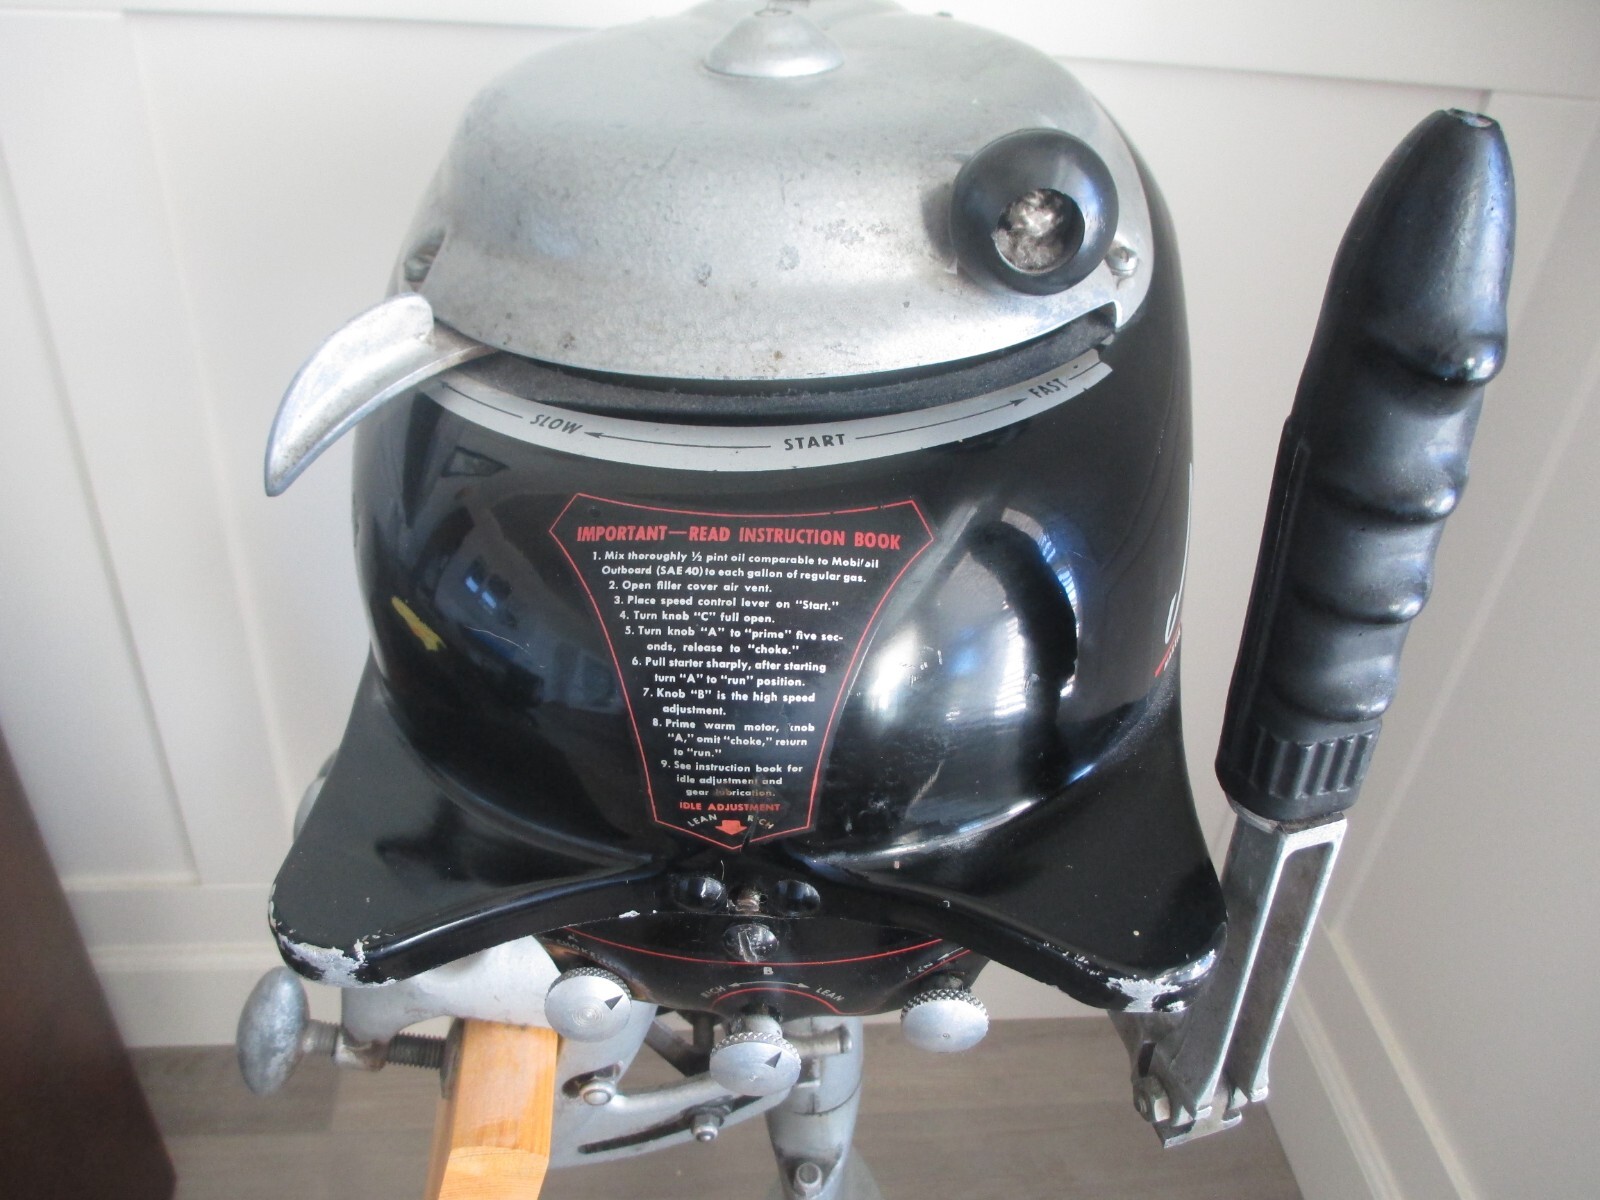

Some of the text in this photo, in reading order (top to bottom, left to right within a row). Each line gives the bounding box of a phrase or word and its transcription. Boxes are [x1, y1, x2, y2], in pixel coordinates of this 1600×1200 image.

[1028, 378, 1068, 398] FAST
[530, 414, 583, 434] SLOW
[784, 434, 845, 451] START
[739, 527, 846, 546] INSTRUCTION
[854, 532, 901, 550] BOOK
[592, 551, 601, 561] 1.
[604, 551, 625, 561] Mix
[627, 551, 687, 563] thoroughly
[706, 553, 728, 563] pint
[730, 553, 745, 562] oil
[748, 556, 815, 566] comparable
[817, 557, 829, 566] to
[601, 565, 867, 583] Outboard (SAE 40) to each gallon of regular gas.
[608, 581, 773, 593] 2. Open filler cover air vent.
[614, 595, 624, 605] 3.
[627, 595, 656, 605] Place
[661, 597, 693, 608] speed
[697, 597, 736, 607] control
[741, 598, 769, 608] lever
[775, 601, 790, 609] on
[619, 611, 630, 620] 4.
[634, 611, 657, 620] Turn
[661, 611, 690, 621] knob
[720, 612, 739, 622] full
[743, 614, 775, 624] open.
[624, 625, 635, 635] 5.
[638, 626, 662, 636] Turn
[667, 626, 695, 636] knob
[730, 628, 741, 637] to
[795, 630, 817, 640] five
[821, 633, 844, 642] sec-
[646, 641, 677, 653] onds,
[682, 641, 723, 652] release
[730, 644, 741, 653] to
[631, 656, 827, 674] 6. Pull starter sharply, after starting
[654, 673, 676, 683] turn
[706, 674, 718, 684] to
[756, 676, 806, 688] position.
[643, 687, 653, 697] 7.
[656, 687, 686, 699] Knob
[716, 690, 726, 700] is
[731, 691, 749, 701] the
[752, 691, 778, 704] high
[782, 692, 816, 704] speed
[662, 703, 727, 716] adjustment.
[652, 717, 662, 727] 8.
[665, 718, 696, 729] Prime
[703, 722, 736, 731] warm
[743, 723, 780, 733] motor,
[696, 734, 721, 744] omit
[673, 747, 684, 756] to
[660, 759, 803, 773] 9. See instruction book for
[676, 774, 783, 786] idle adjustment and
[685, 788, 710, 797] gear
[679, 801, 781, 812] IDLE ADJUSTMENT
[687, 813, 718, 828] LEAN
[747, 814, 775, 830] RCH
[763, 966, 774, 976] B
[815, 987, 845, 1002] LEAN
